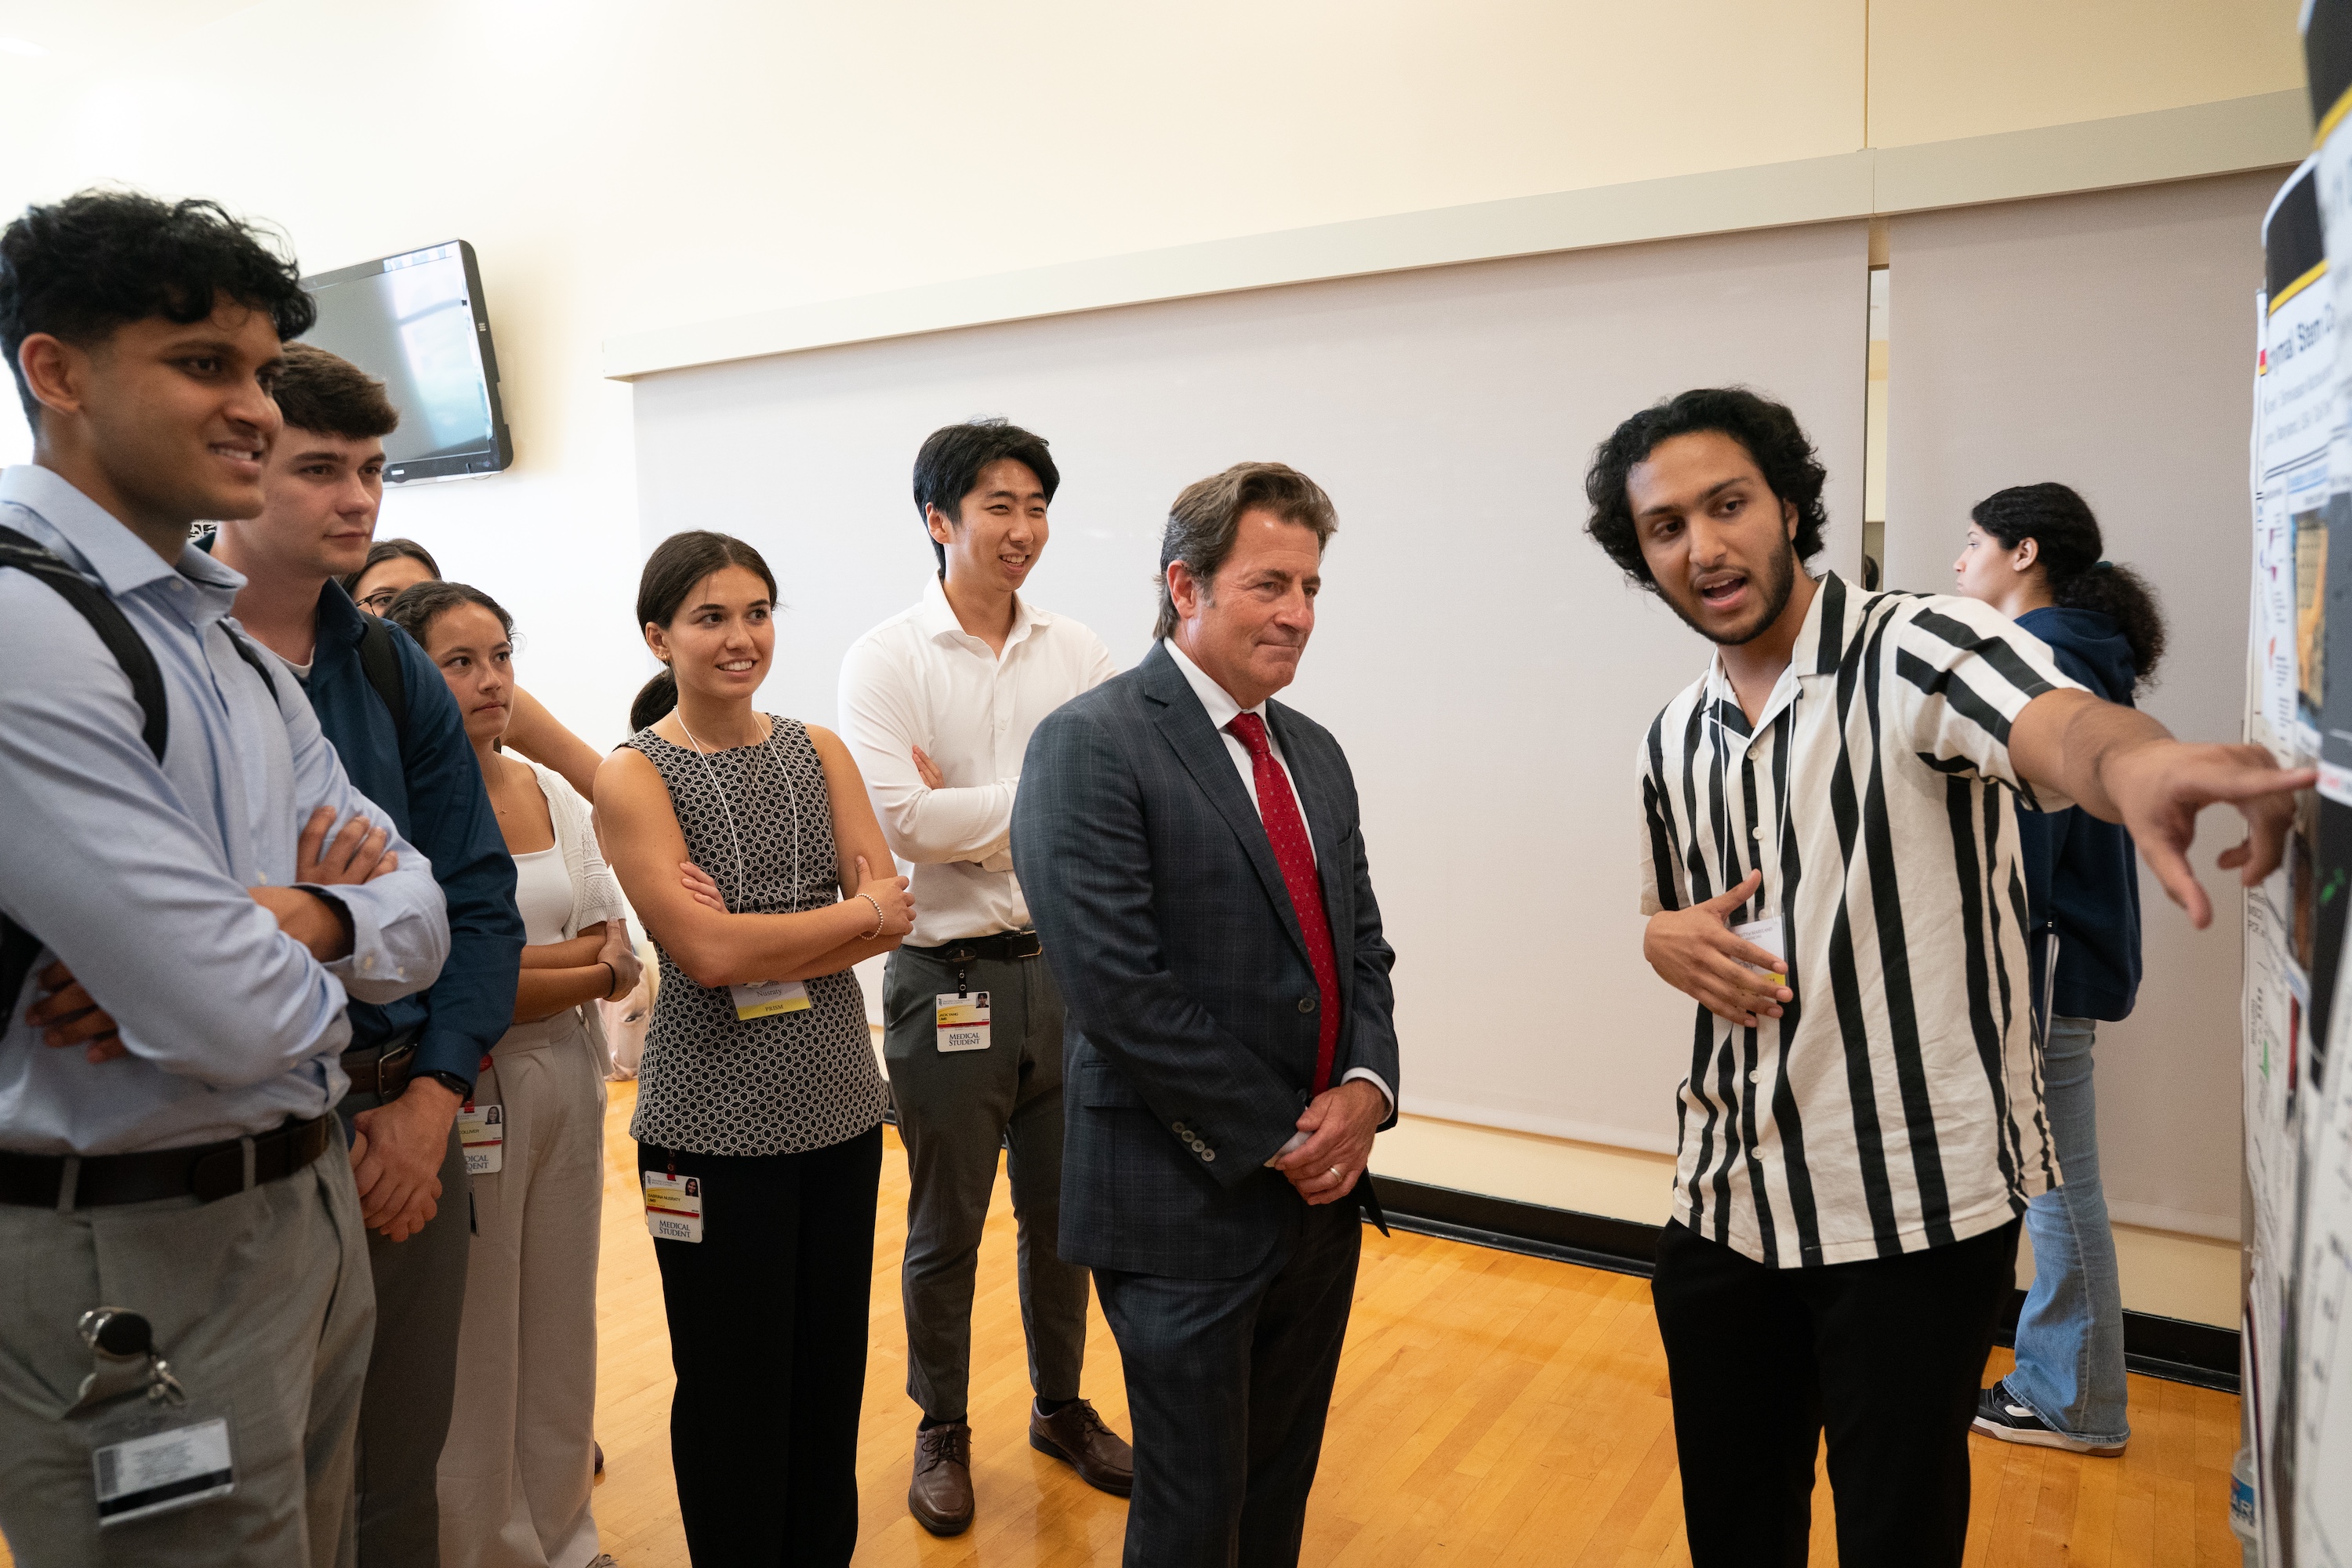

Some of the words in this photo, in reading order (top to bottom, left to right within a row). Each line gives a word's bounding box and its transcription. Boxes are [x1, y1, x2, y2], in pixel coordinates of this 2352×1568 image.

[757, 988, 782, 997] Nusraty
[659, 1220, 690, 1231] MEDICAL
[659, 1227, 691, 1237] STUDENT
